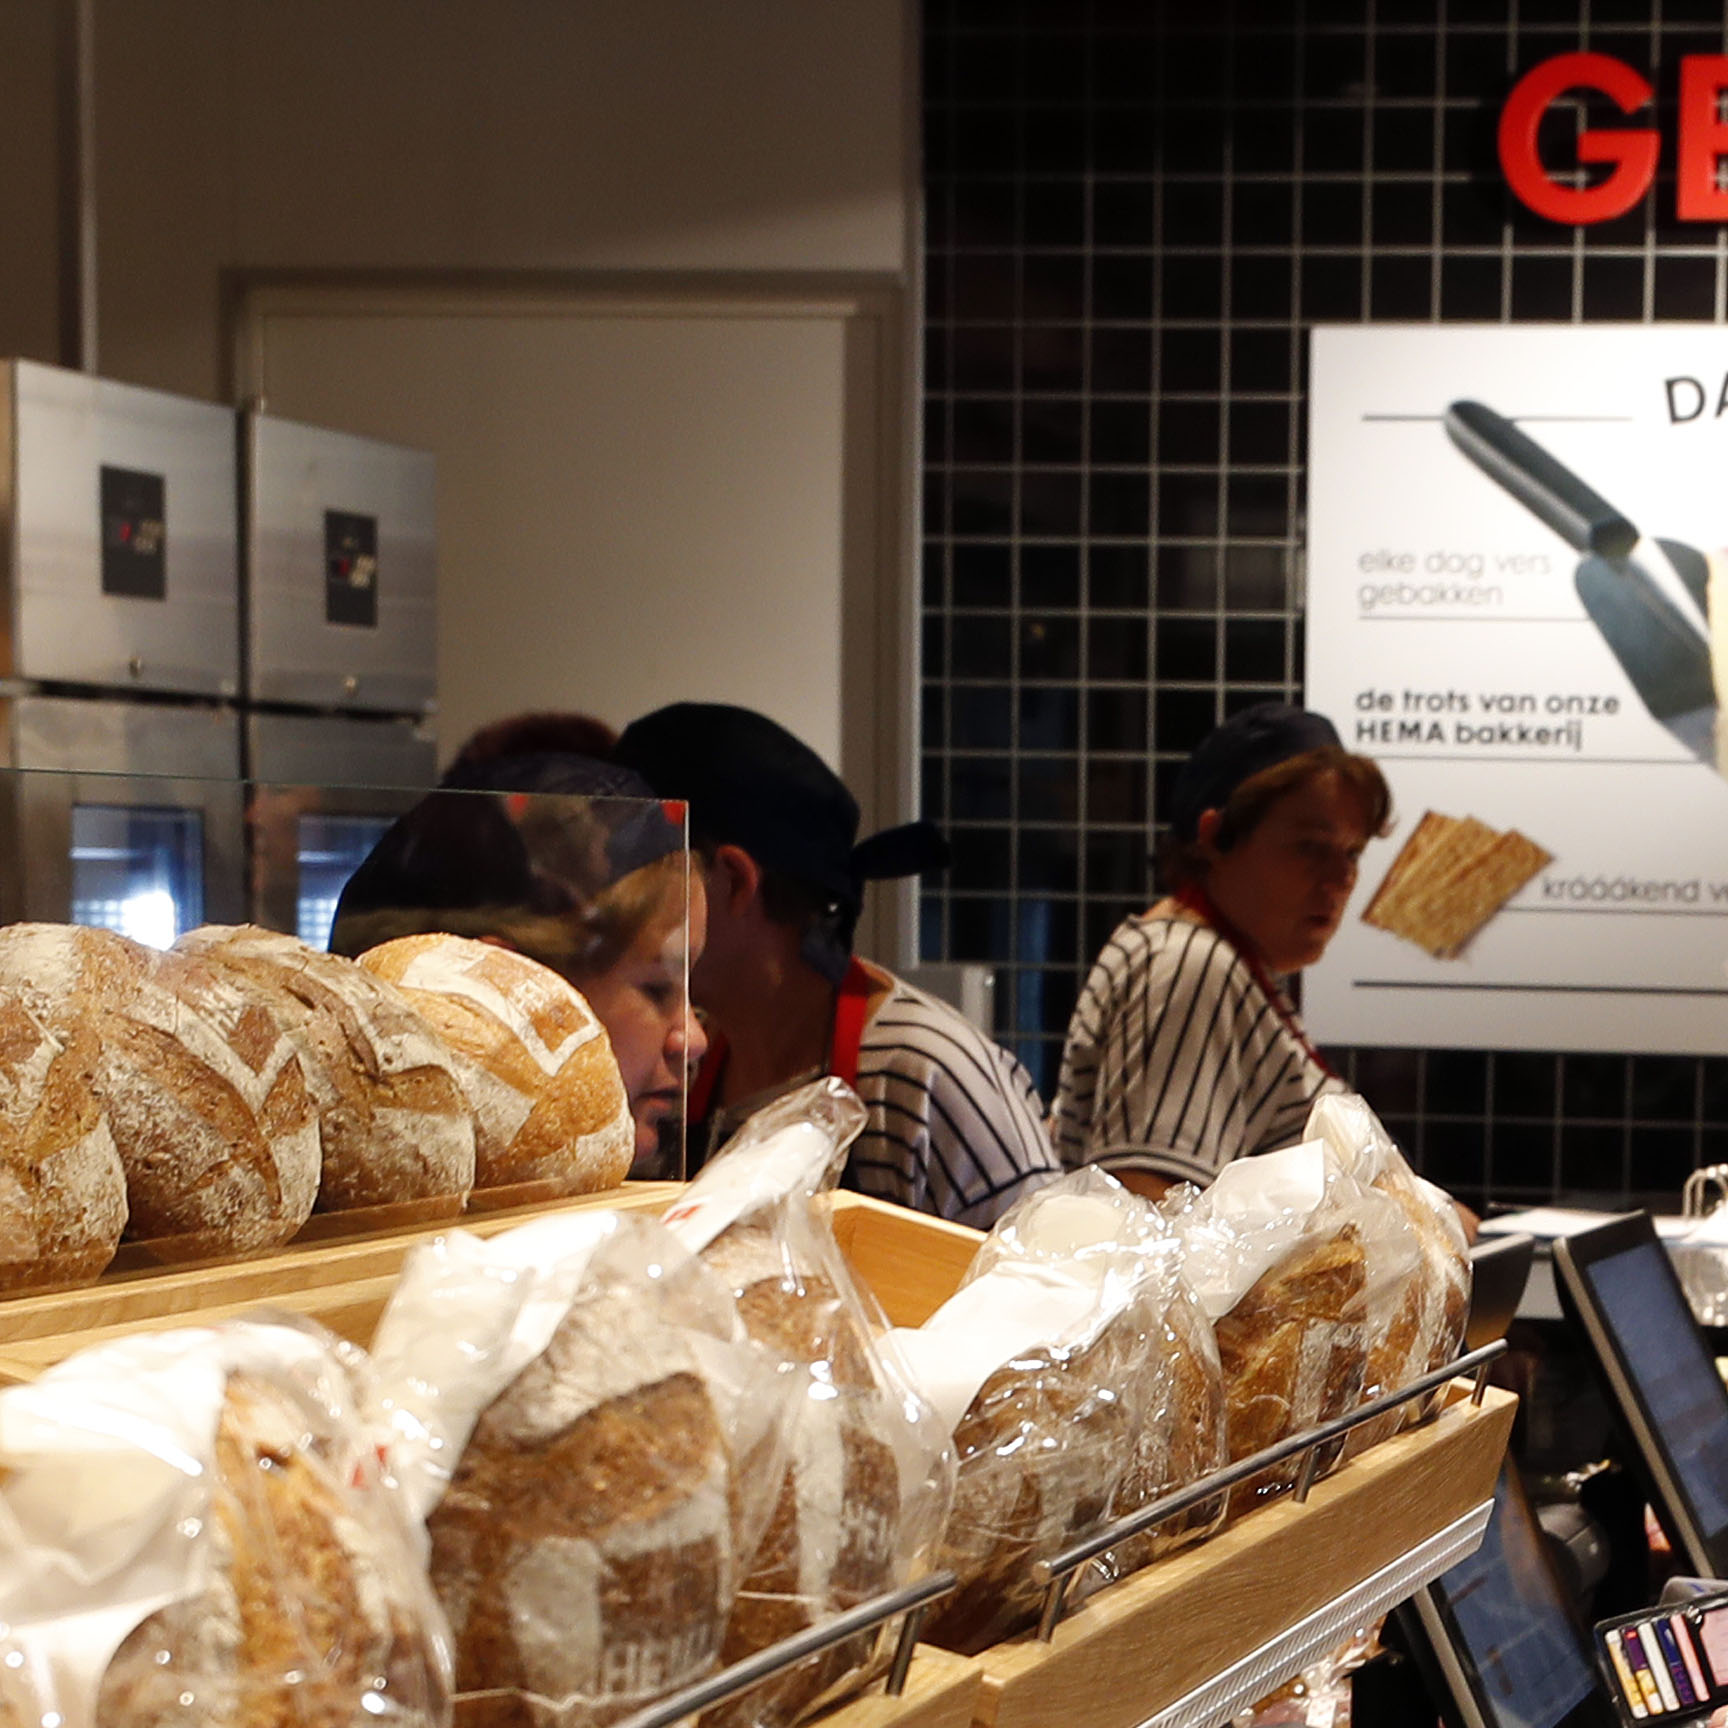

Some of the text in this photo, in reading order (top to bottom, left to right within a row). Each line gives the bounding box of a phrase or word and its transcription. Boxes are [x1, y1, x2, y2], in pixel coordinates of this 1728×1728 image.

[1358, 550, 1552, 579] elke dag vers
[1355, 688, 1619, 714] de trots van onze
[1356, 721, 1583, 752] HEMA bakkerij
